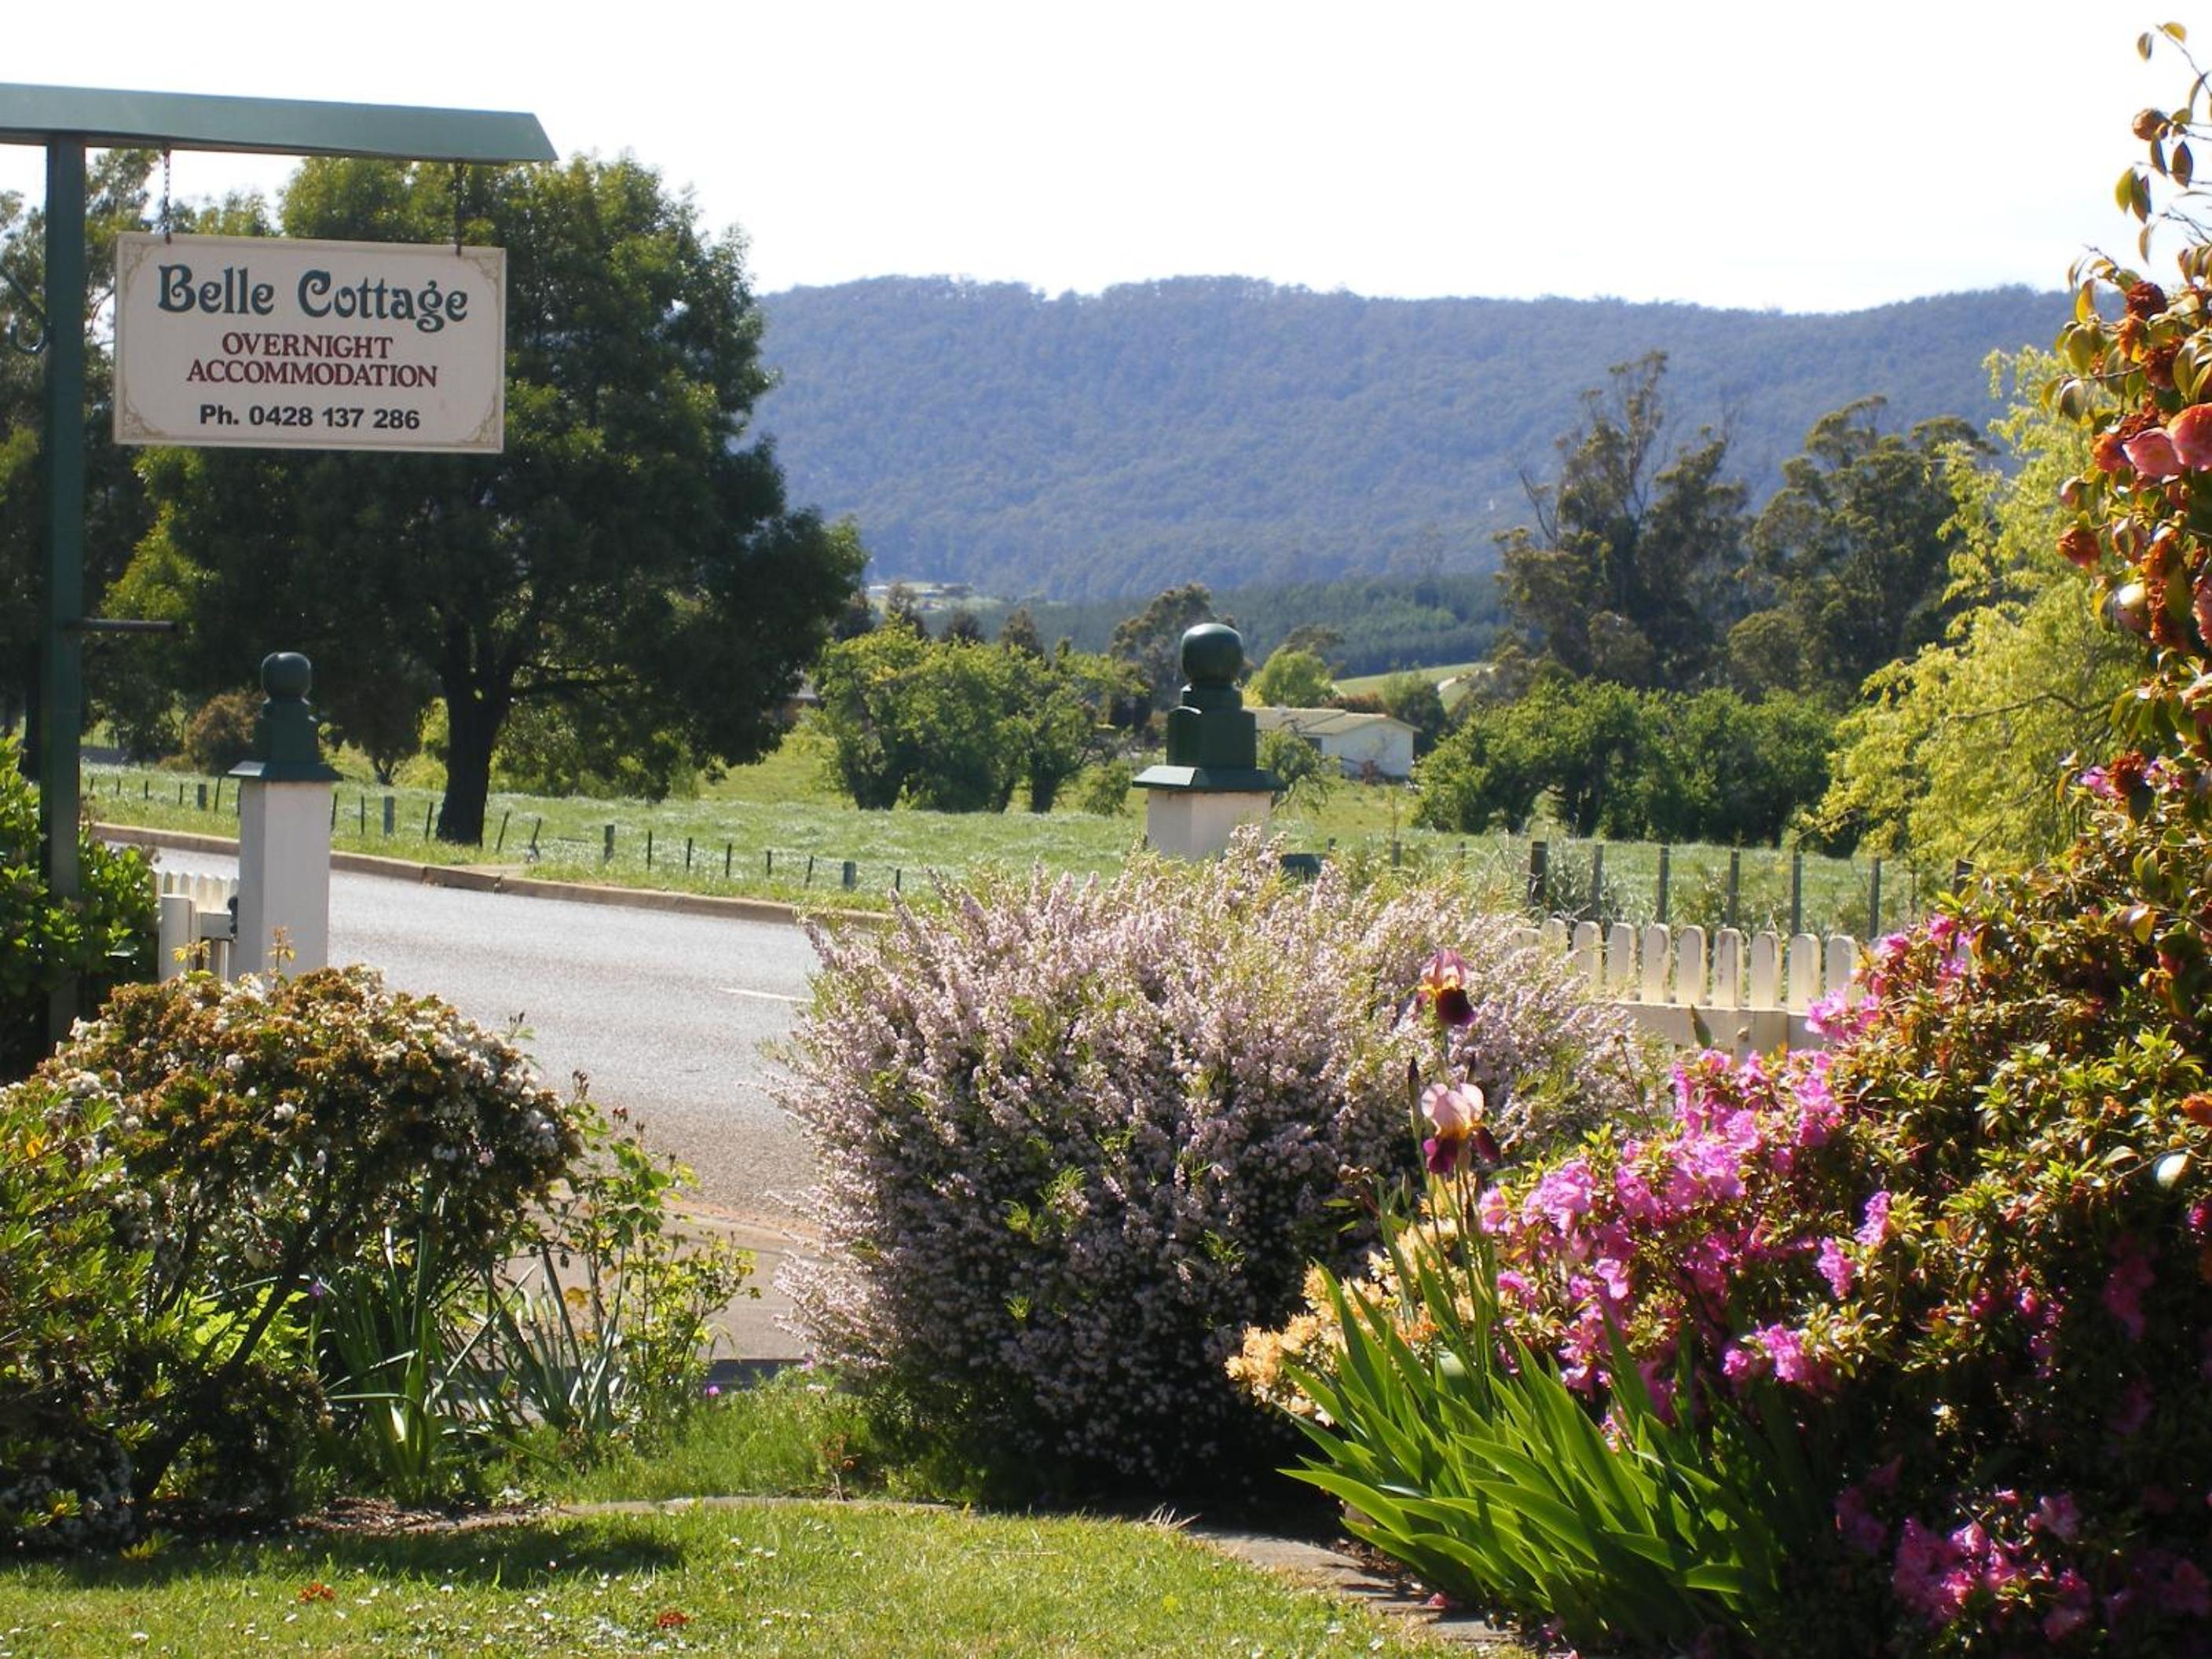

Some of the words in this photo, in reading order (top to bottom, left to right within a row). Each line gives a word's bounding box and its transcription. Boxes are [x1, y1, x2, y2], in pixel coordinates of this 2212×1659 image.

[158, 265, 274, 315] Belle
[298, 269, 468, 333] Cottage
[222, 332, 393, 359] OVERNIGHT
[187, 360, 438, 387] ACCOMMODATION
[200, 405, 239, 425] Ph.
[249, 405, 313, 427] 0428
[322, 407, 364, 428] 137
[373, 408, 419, 430] 286
